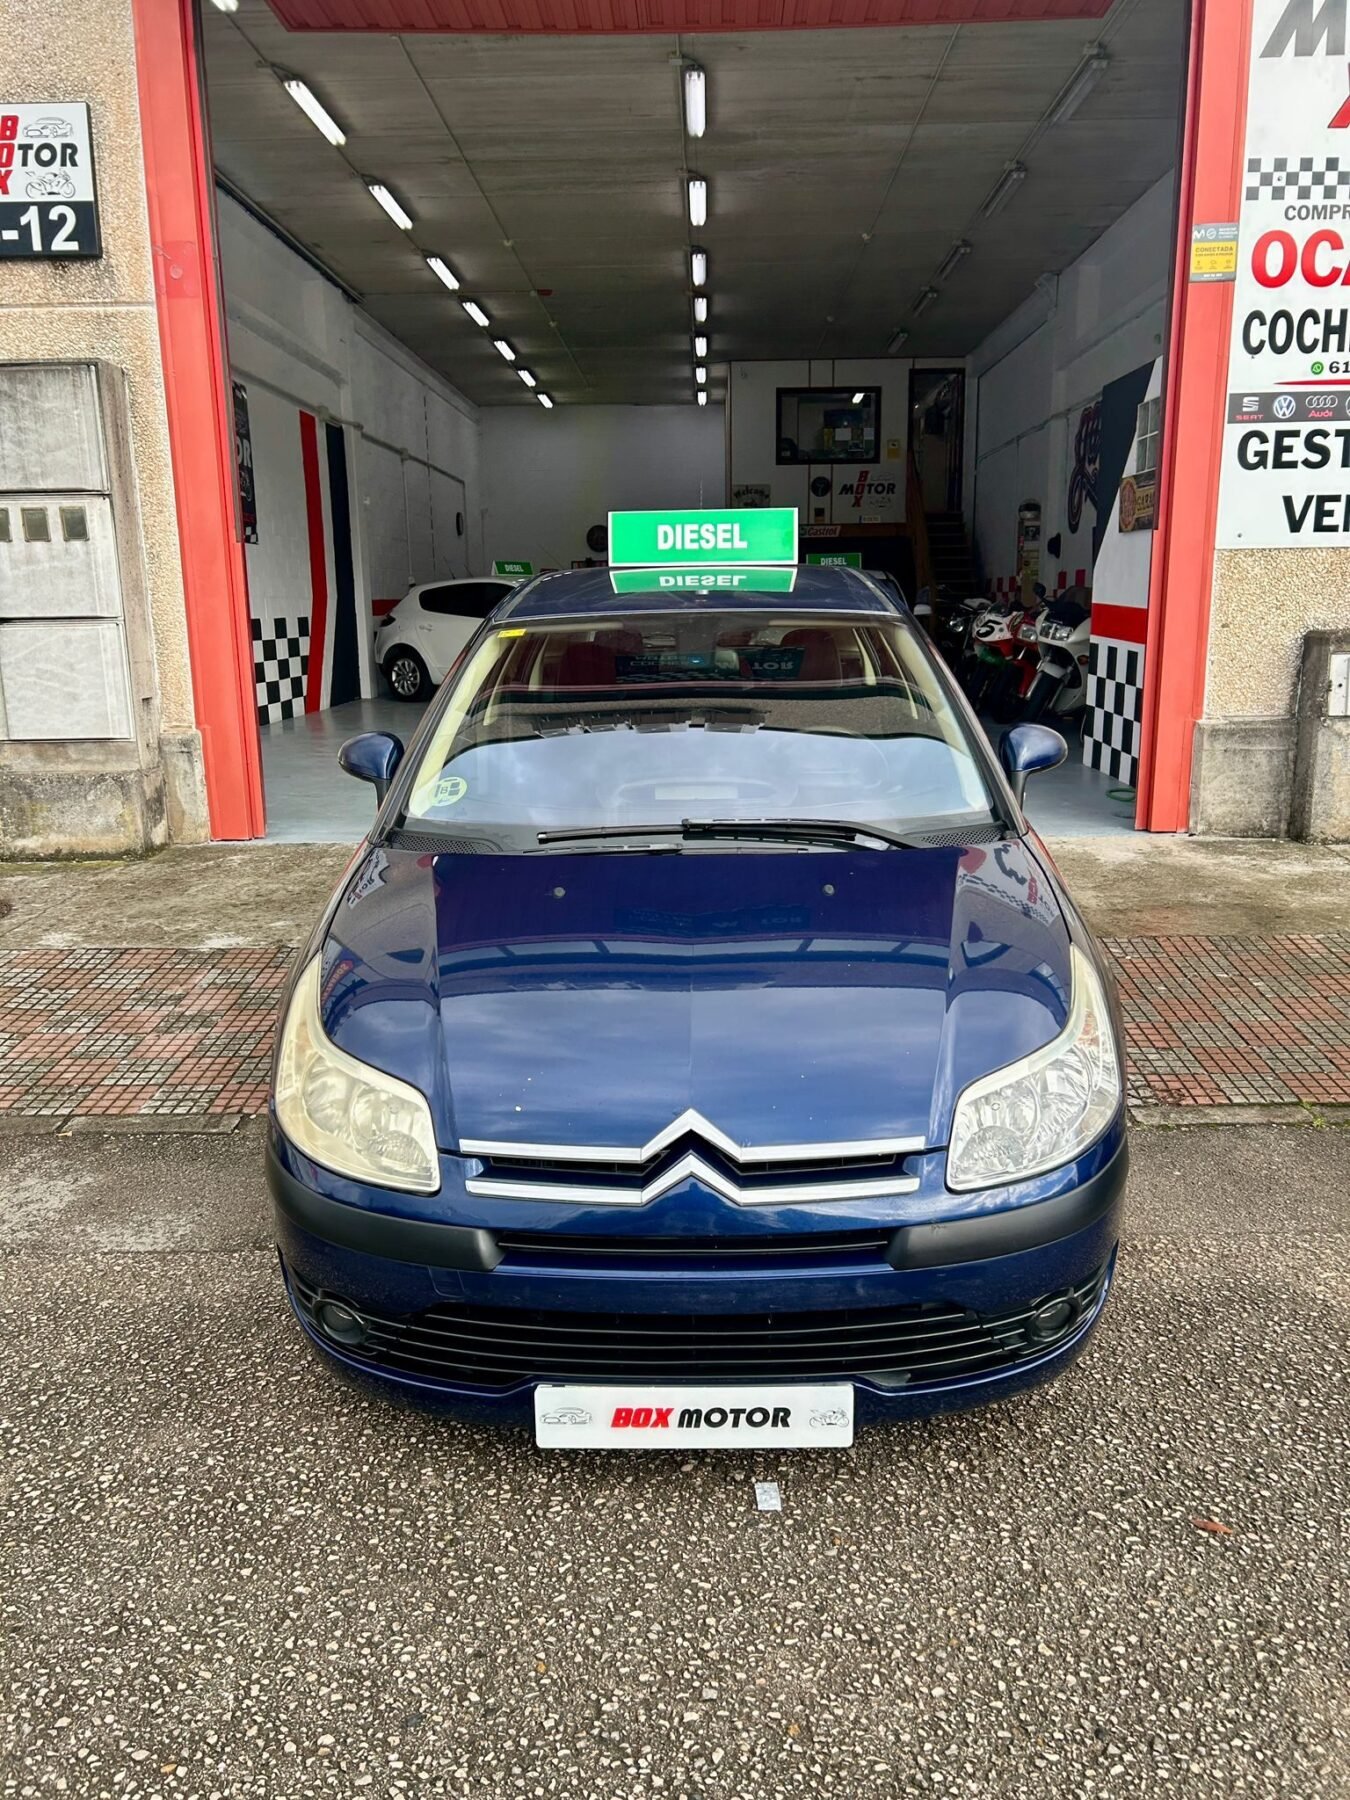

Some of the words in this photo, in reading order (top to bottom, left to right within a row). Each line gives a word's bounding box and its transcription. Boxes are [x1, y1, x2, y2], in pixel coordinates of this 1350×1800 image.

[1251, 229, 1350, 288] OC
[1242, 308, 1350, 356] COCH
[1308, 409, 1333, 418] Audi
[1283, 494, 1350, 534] VE
[657, 523, 748, 550] DIESEL
[808, 526, 838, 537] Castrol
[504, 564, 524, 573] DIESEL
[820, 557, 847, 567] DIESEL
[976, 619, 1003, 638] 5
[610, 1407, 674, 1428] BOX
[677, 1407, 792, 1428] MOTOR
